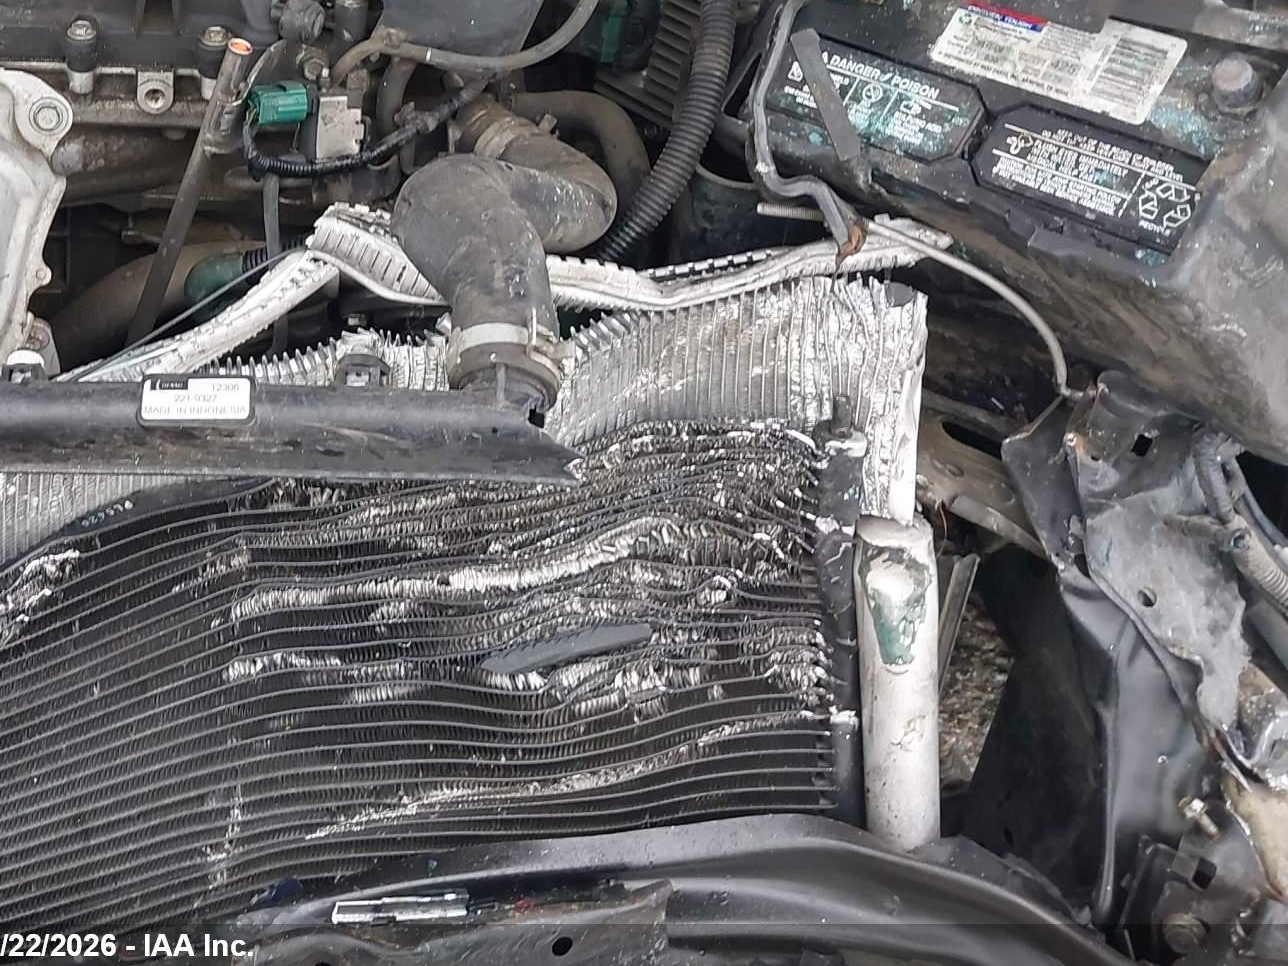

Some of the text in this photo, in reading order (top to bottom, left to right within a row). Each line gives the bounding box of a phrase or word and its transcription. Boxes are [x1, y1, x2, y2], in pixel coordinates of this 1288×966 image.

[144, 405, 247, 415] MADE IN INDONESIA
